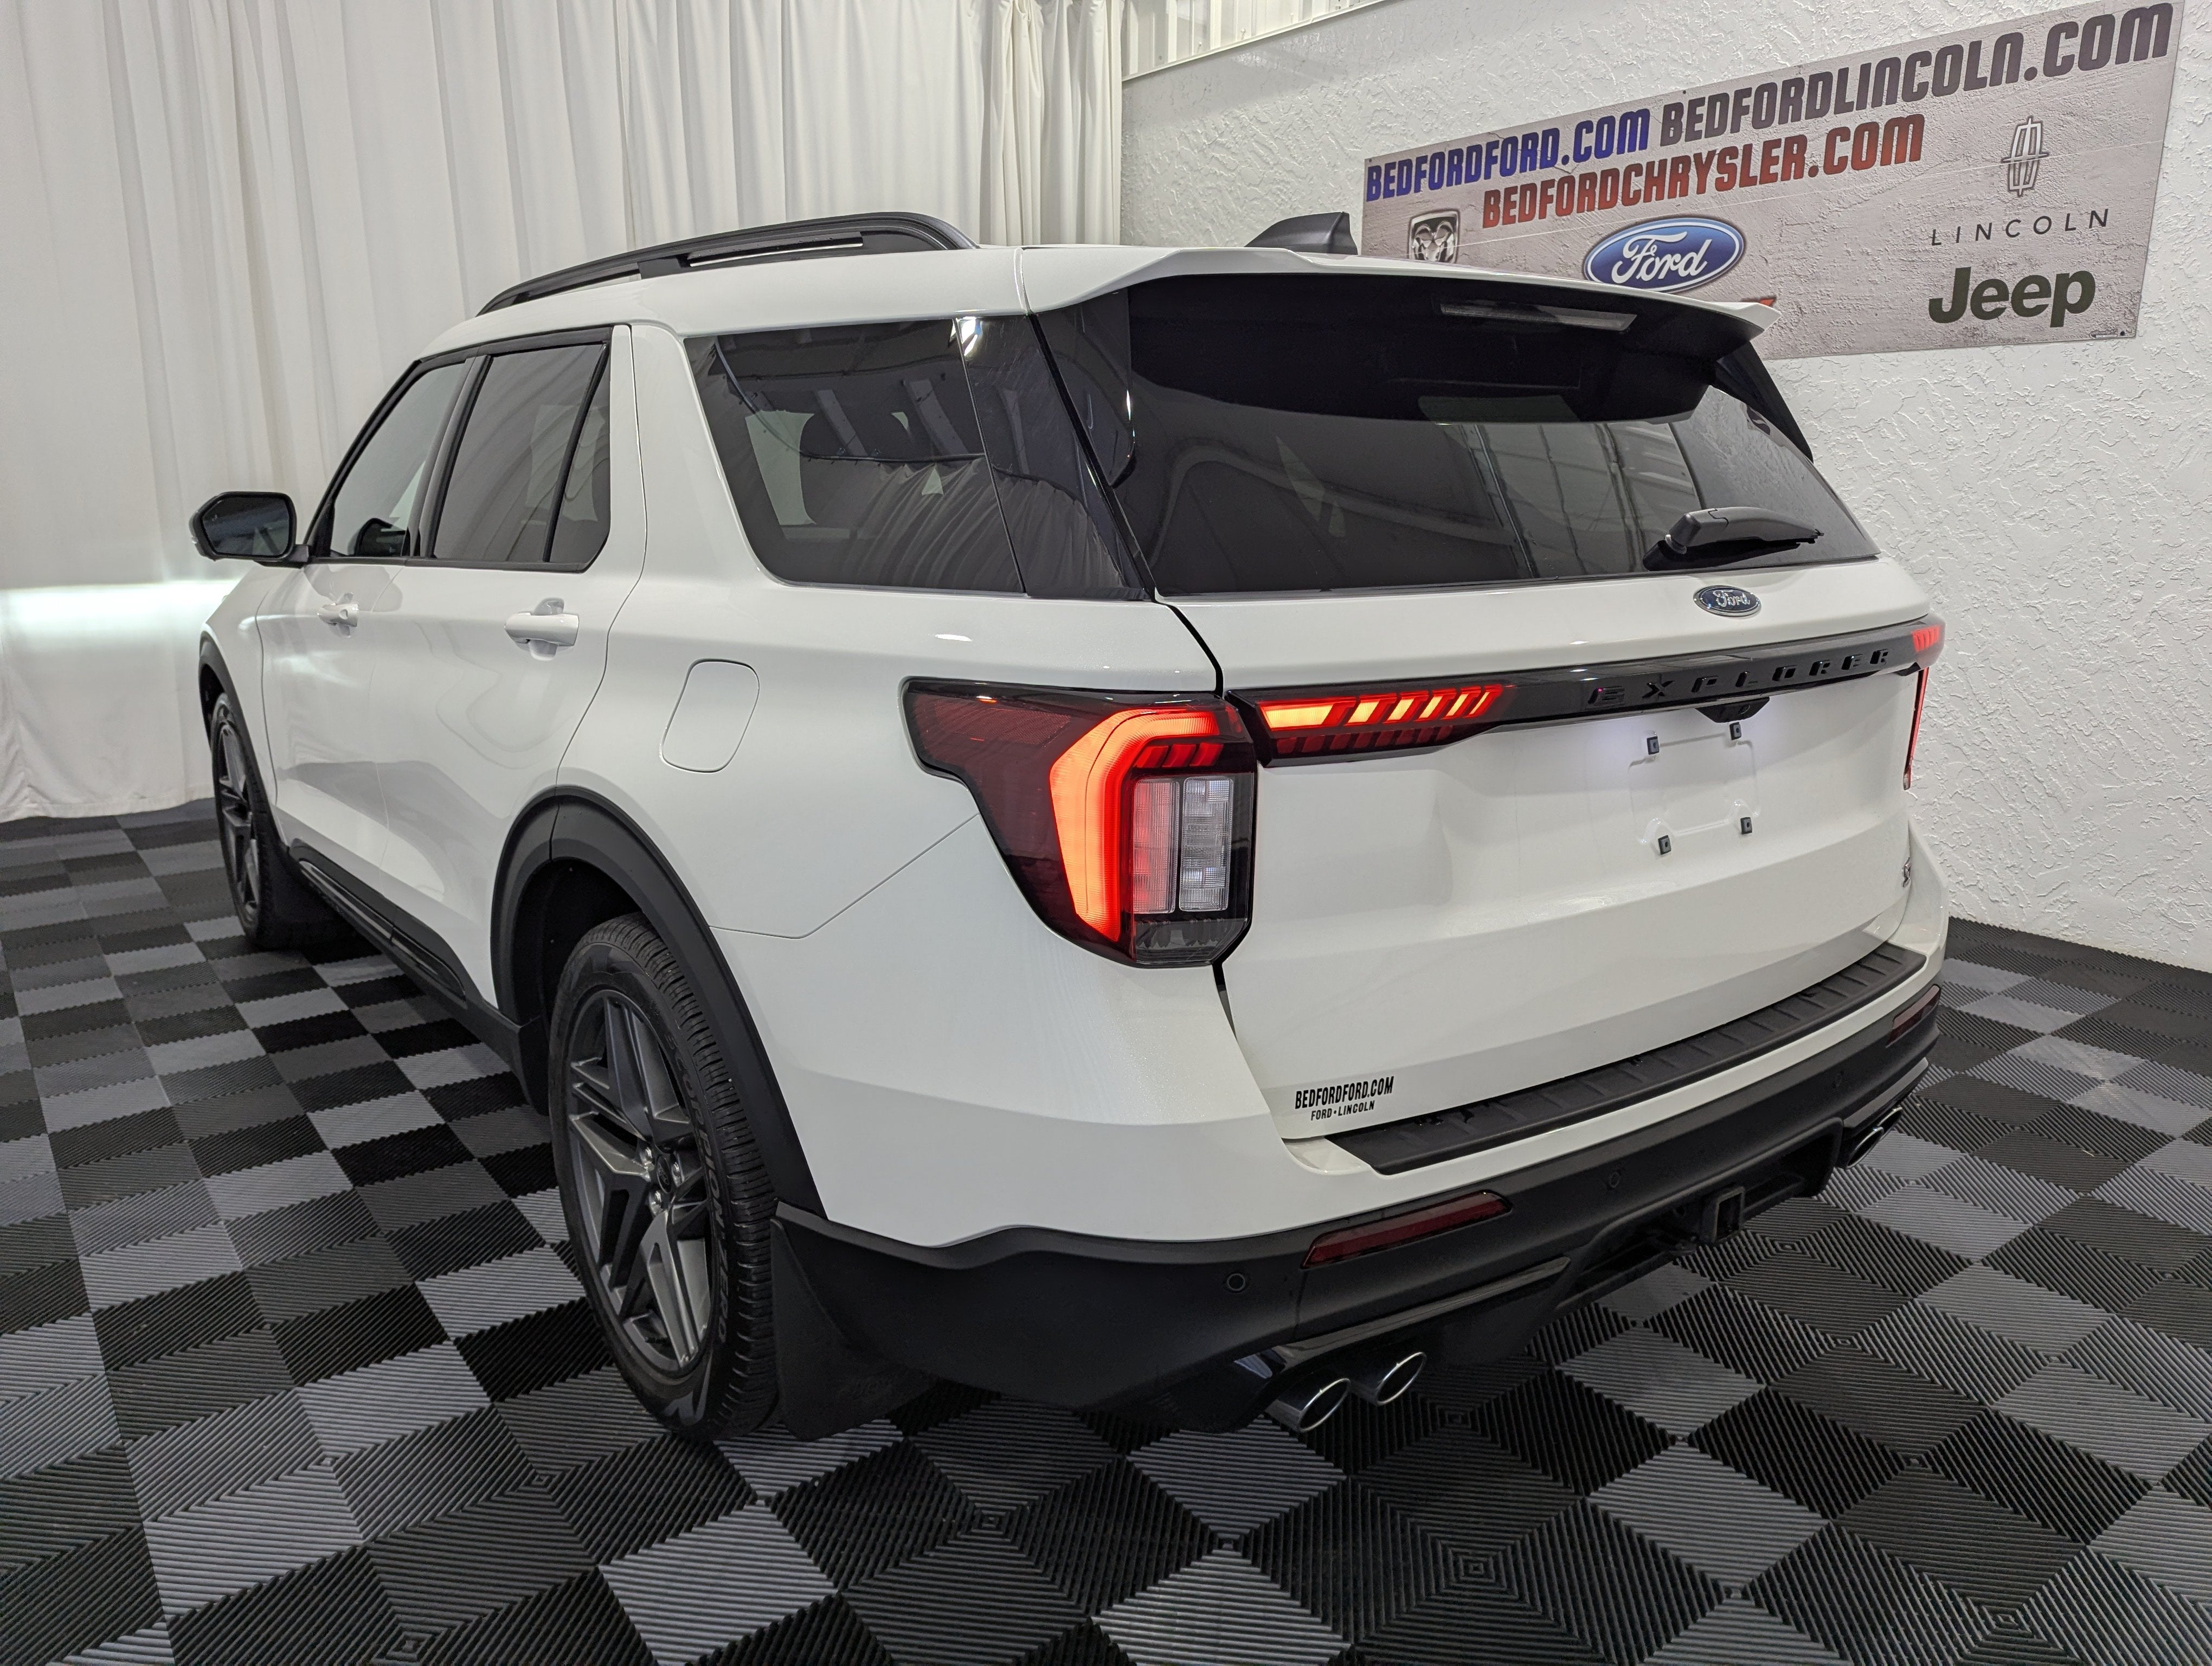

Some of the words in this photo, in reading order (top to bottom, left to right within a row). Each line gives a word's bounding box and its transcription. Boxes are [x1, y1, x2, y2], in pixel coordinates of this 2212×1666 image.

[1366, 108, 1651, 202] BEDFORDFORD.COM
[1660, 2, 2174, 146] BEDFORDLINCOLN.COM
[1482, 113, 1925, 229] BEDFORDCHRYSLER.COM
[1931, 208, 2108, 246] LINCOLN
[1611, 230, 1712, 283] Ford
[1928, 266, 2096, 328] Jeep
[1712, 589, 1751, 607] Ford
[1587, 648, 1890, 704] EXPLORER
[1295, 1076, 1394, 1109] BEDFORDFORD.COM
